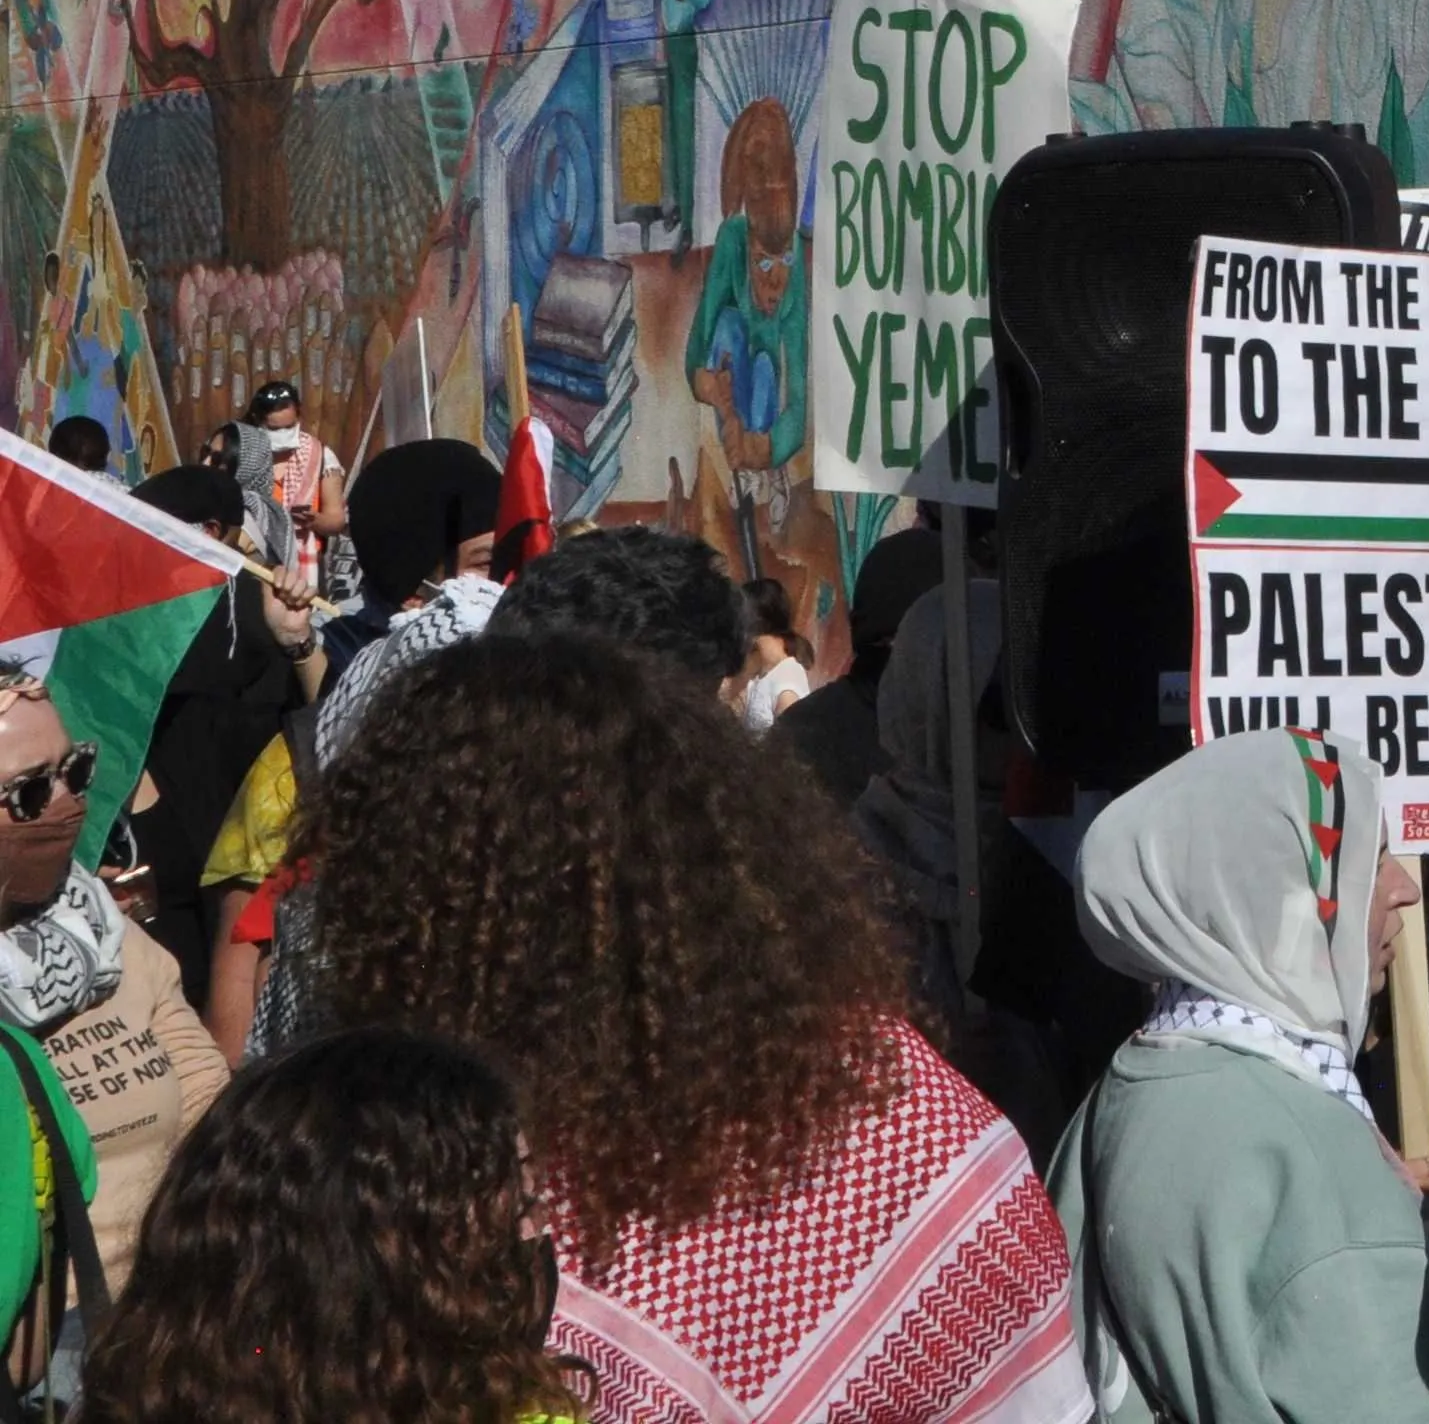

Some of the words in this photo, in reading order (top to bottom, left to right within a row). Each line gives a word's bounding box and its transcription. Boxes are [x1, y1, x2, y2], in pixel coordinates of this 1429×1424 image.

[847, 8, 1027, 163] STOP
[1201, 250, 1325, 325] FROM
[1340, 262, 1420, 331] THE
[1201, 335, 1279, 435] TO
[1302, 343, 1419, 440] THE
[92, 1047, 119, 1072] AT
[120, 1028, 157, 1056] THE
[100, 1072, 128, 1095] OF
